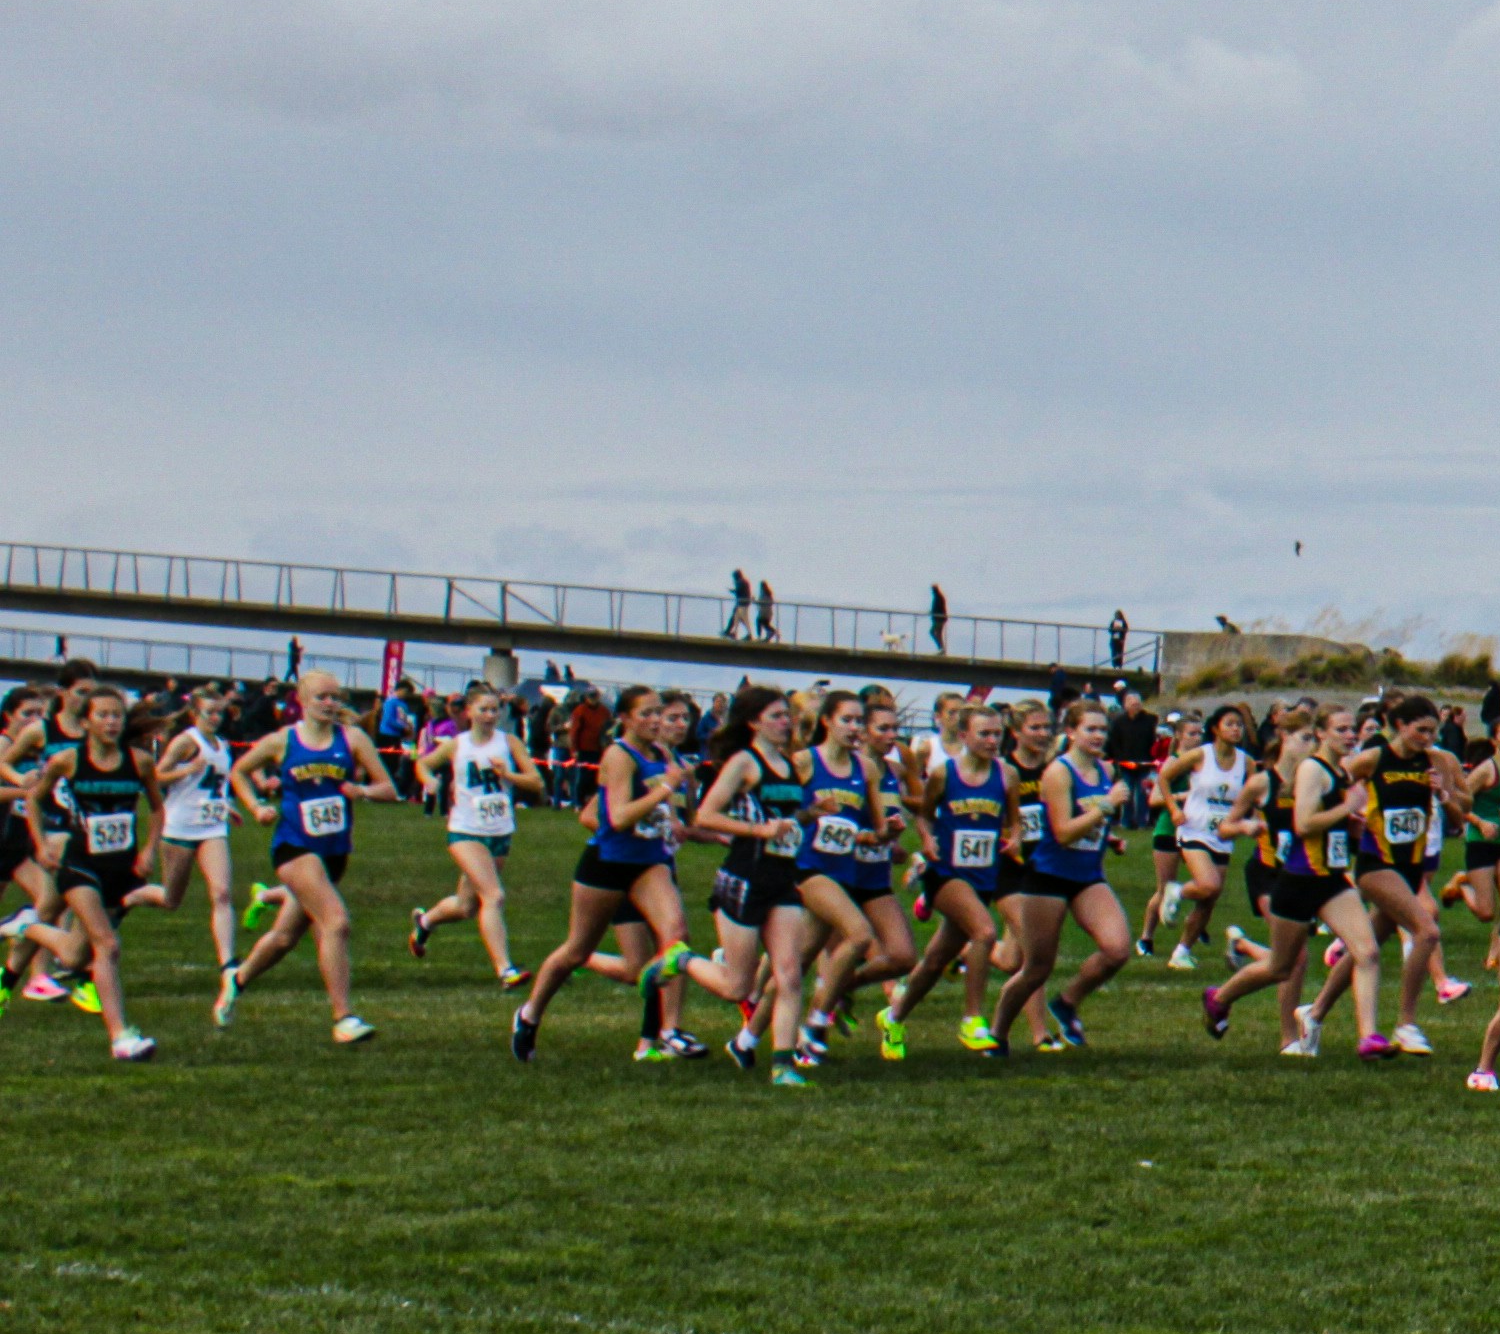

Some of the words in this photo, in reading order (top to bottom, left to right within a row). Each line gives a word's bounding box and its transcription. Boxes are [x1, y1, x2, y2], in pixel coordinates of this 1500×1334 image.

[310, 804, 341, 828] 649
[94, 823, 129, 844] 523
[822, 822, 852, 847] 642
[960, 838, 990, 860] 641
